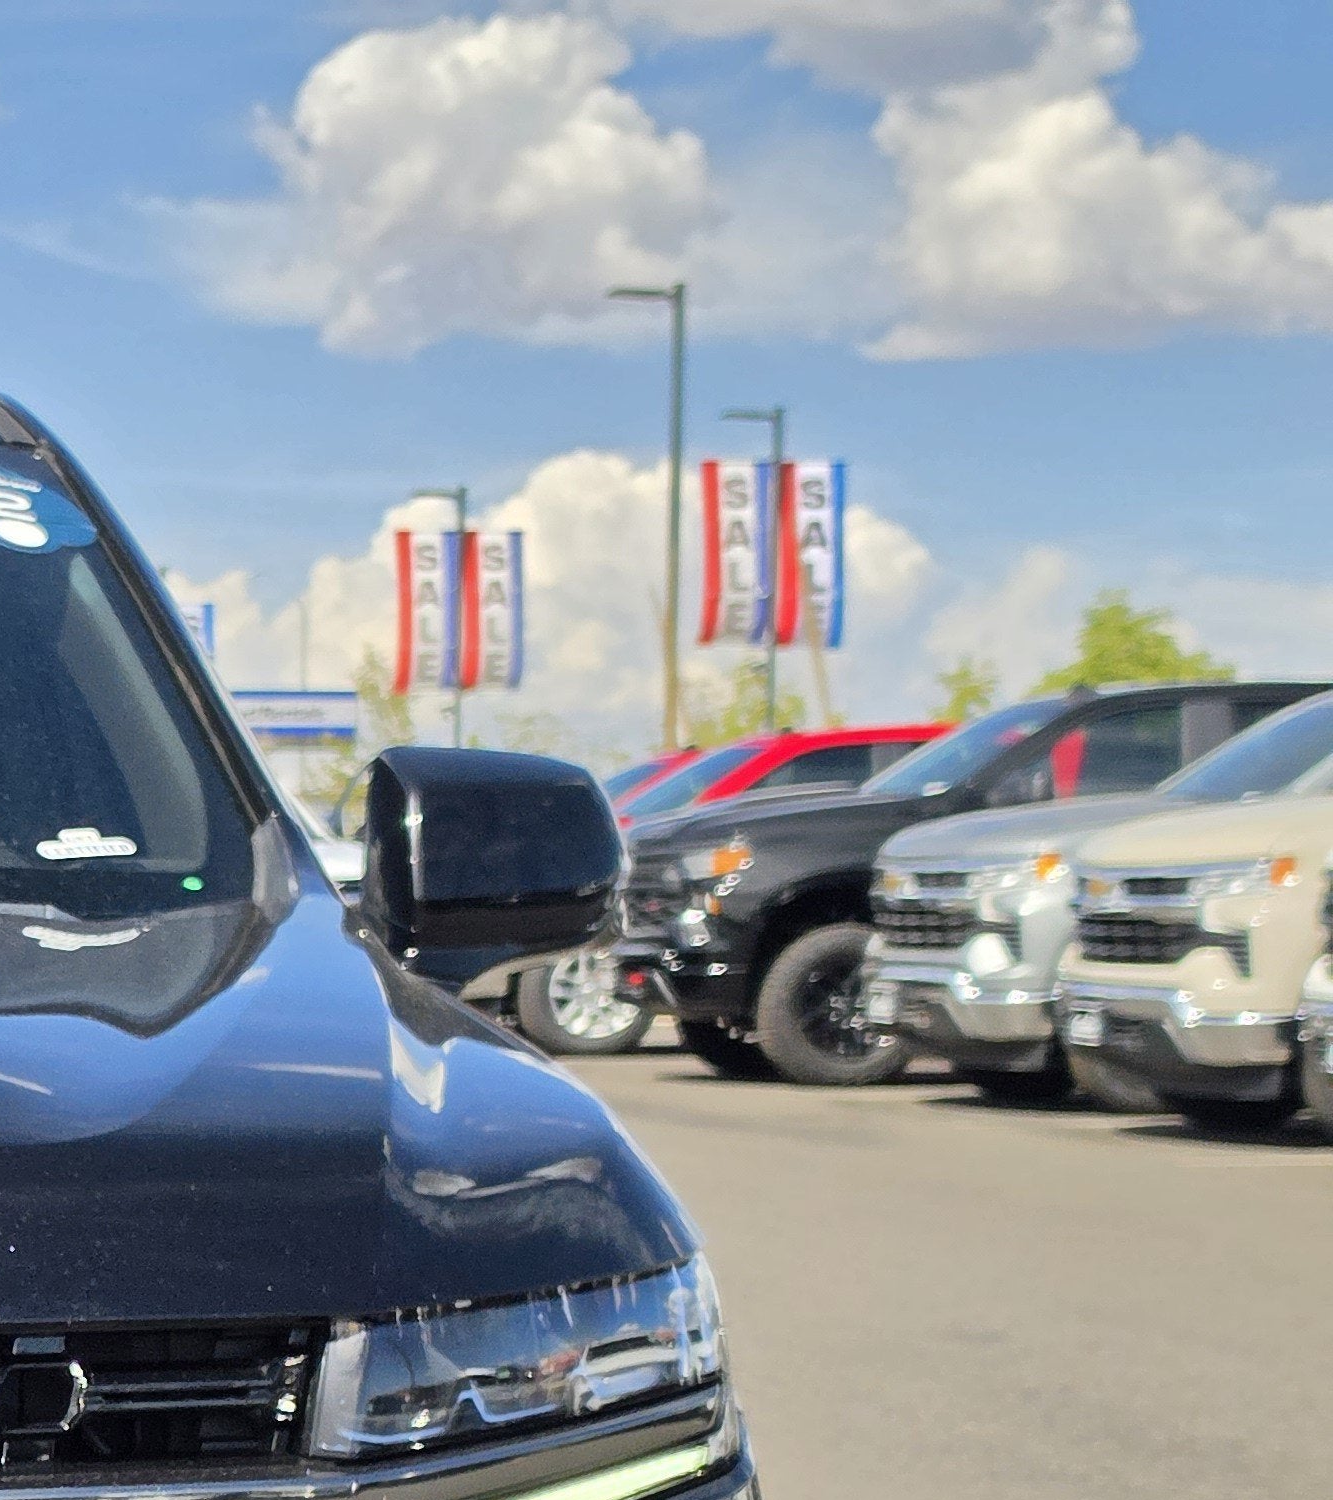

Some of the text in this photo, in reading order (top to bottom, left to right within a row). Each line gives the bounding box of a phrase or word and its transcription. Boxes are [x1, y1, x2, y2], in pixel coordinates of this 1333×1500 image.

[415, 543, 441, 684] SALE
[483, 544, 509, 684] SALE
[723, 478, 750, 637] SALE
